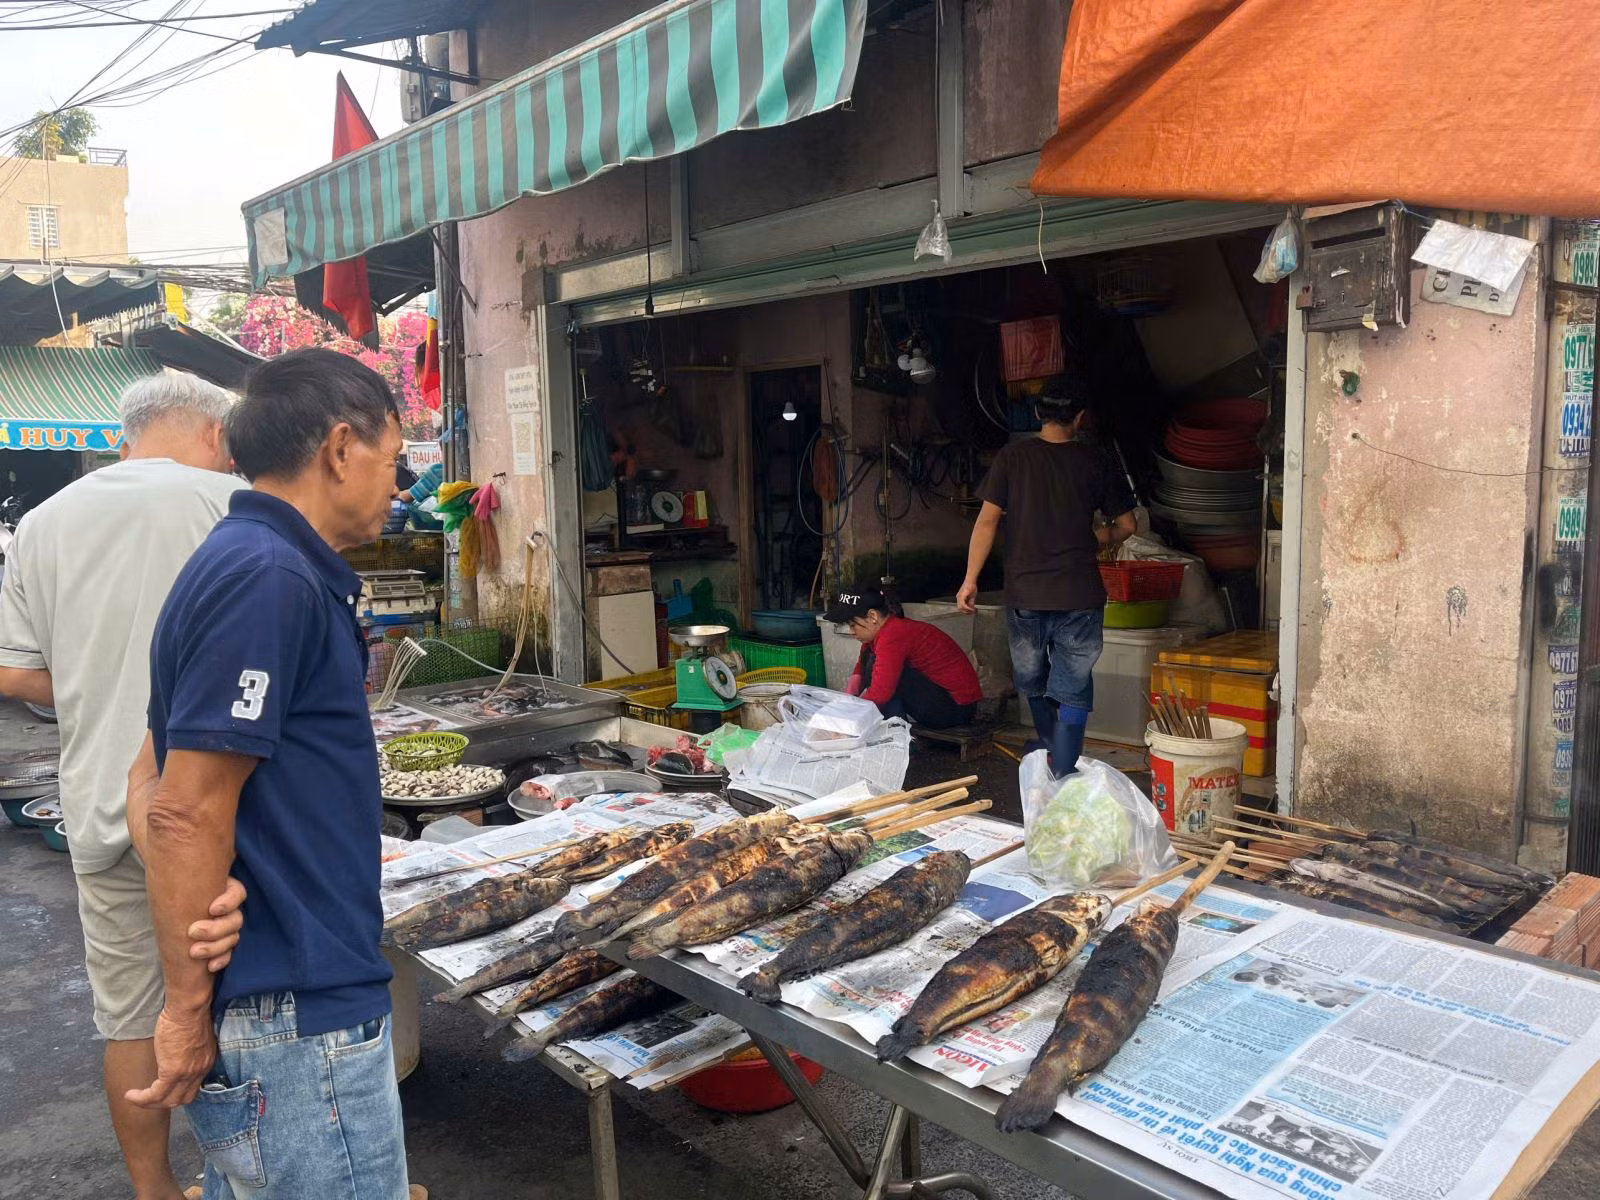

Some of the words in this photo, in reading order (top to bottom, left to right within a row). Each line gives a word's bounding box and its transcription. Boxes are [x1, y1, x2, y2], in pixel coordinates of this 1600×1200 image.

[19, 427, 93, 447] HUY
[101, 429, 124, 448] V
[231, 669, 270, 721] 3
[1085, 1080, 1136, 1107] TPHCM
